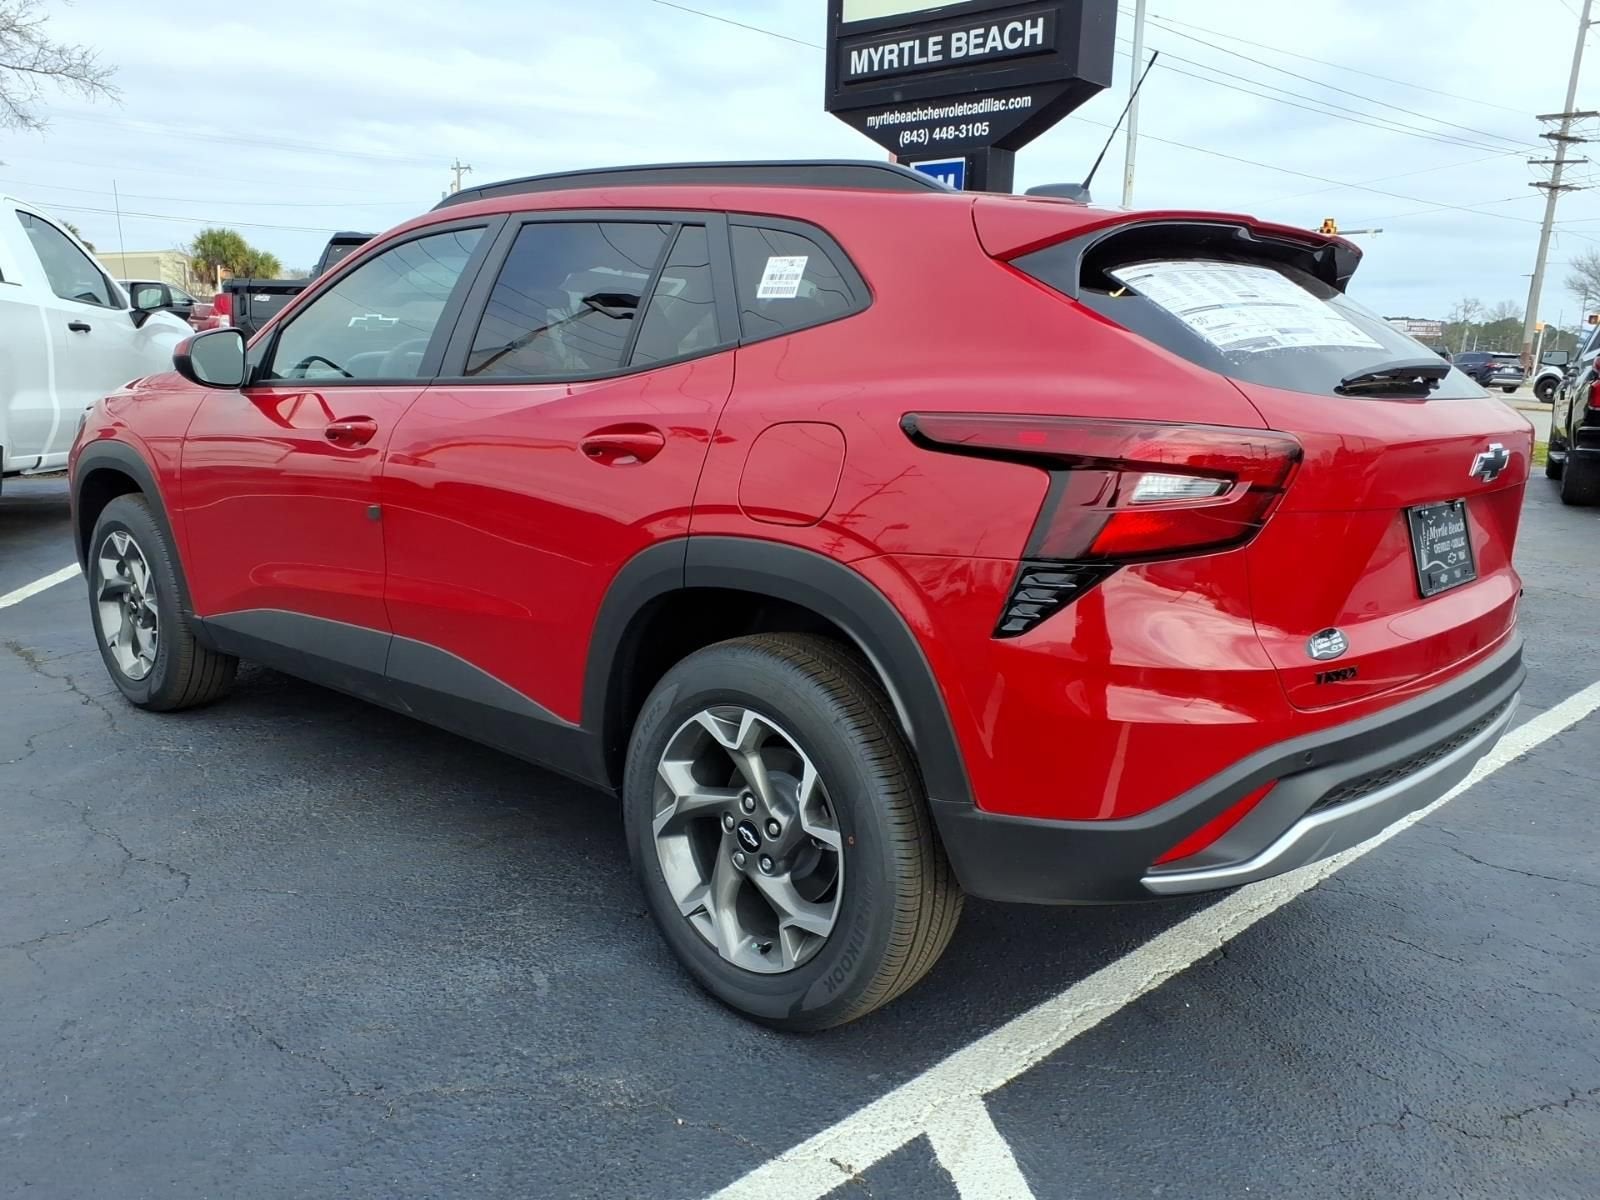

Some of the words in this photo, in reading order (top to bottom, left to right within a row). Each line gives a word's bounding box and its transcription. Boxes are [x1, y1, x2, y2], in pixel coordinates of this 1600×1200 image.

[850, 35, 943, 75] MYRTLE
[950, 17, 1044, 59] BEACH
[866, 95, 1032, 129] myrtlebeachchevroletcadillac.com
[899, 128, 930, 148] (843)
[932, 122, 990, 141] 448-3105
